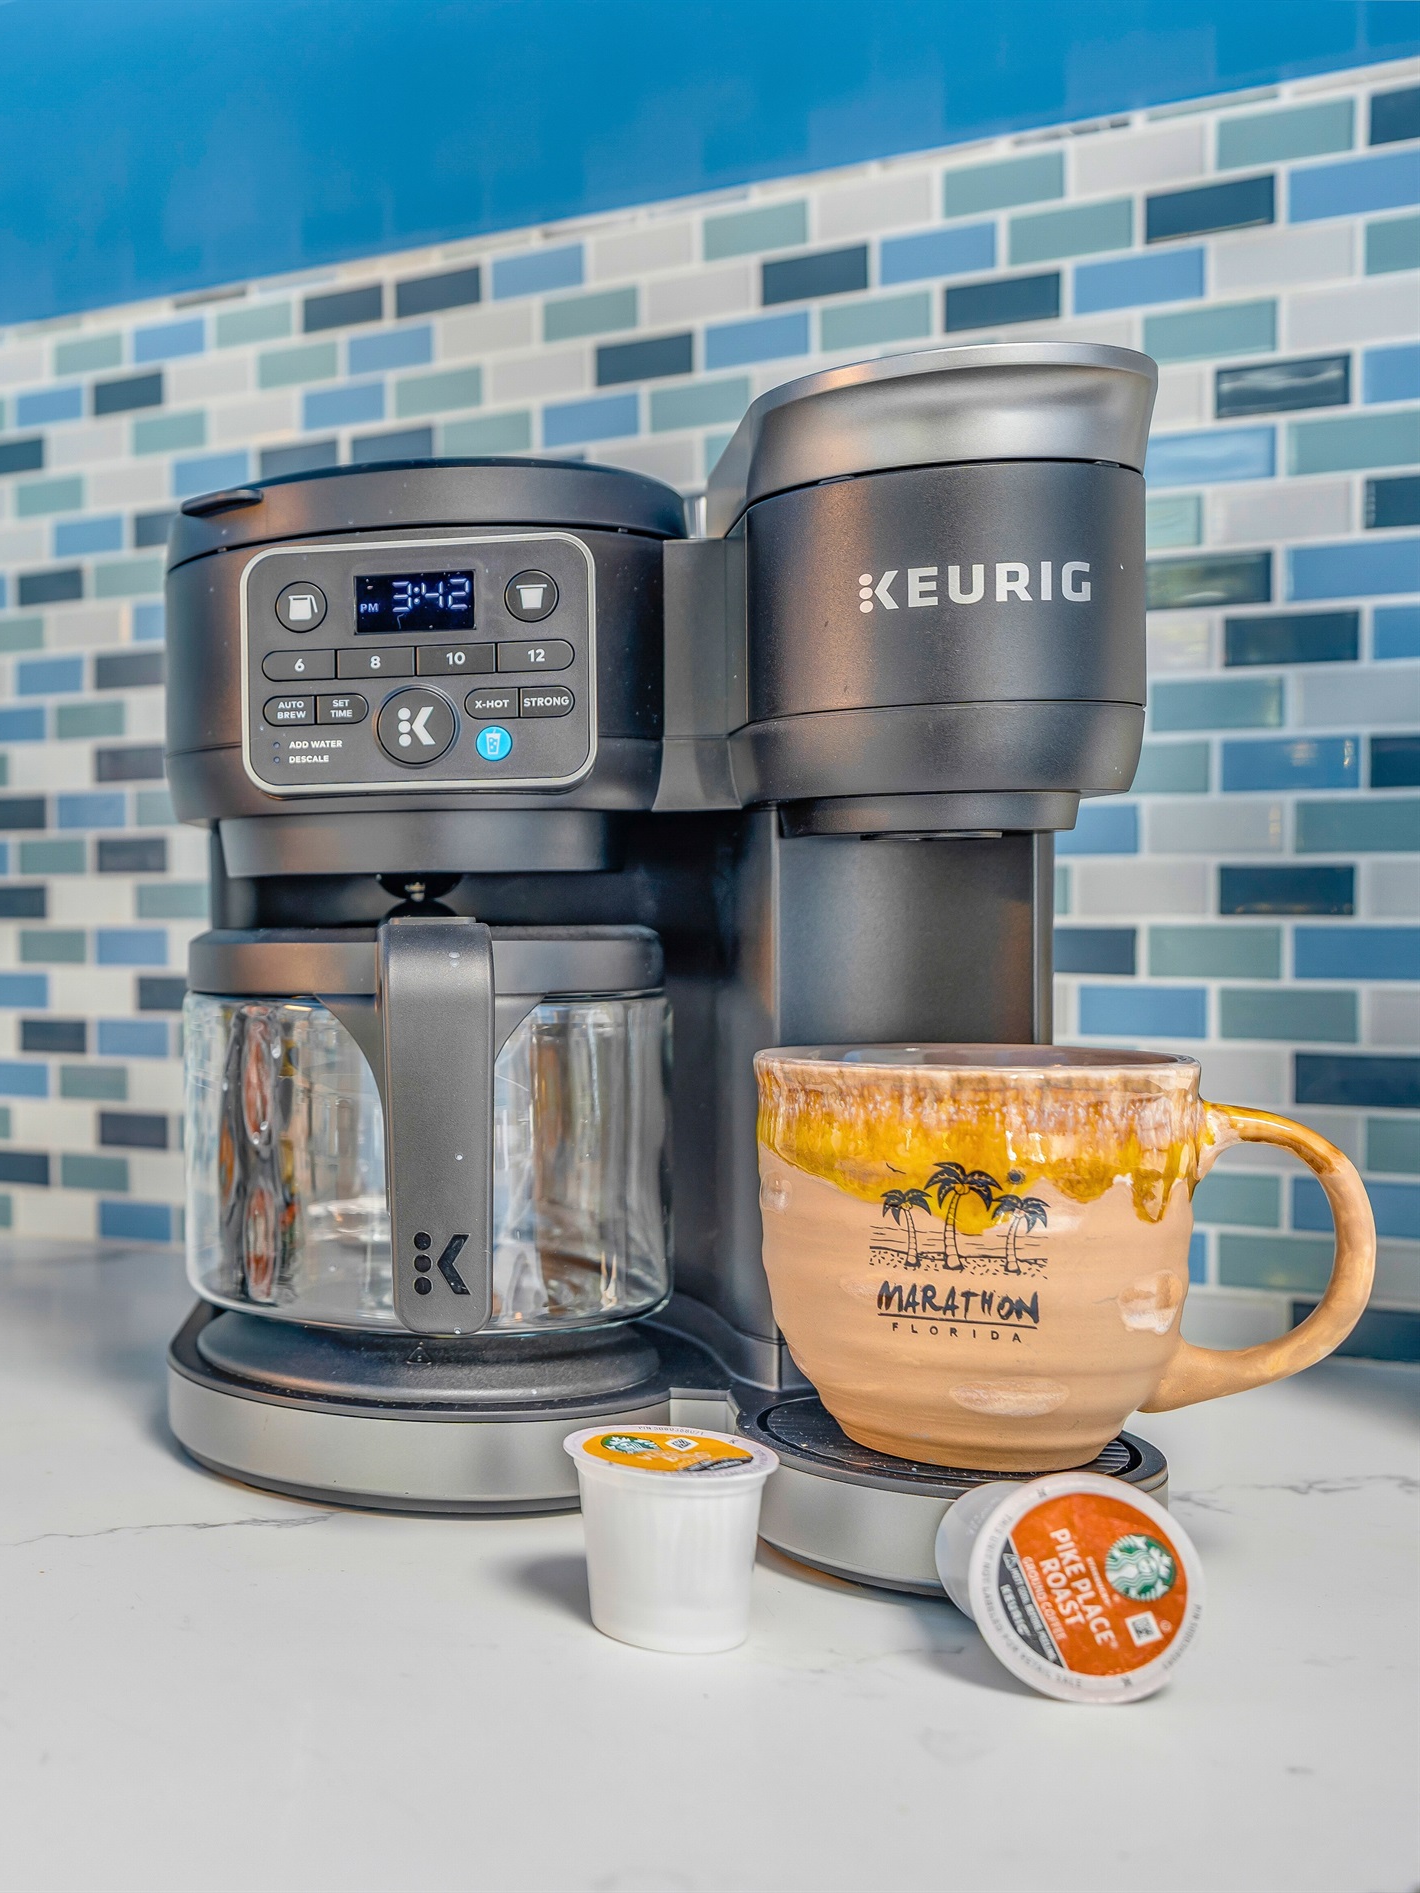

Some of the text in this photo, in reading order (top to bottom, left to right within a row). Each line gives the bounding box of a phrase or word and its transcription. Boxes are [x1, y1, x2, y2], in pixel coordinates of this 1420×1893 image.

[858, 560, 1091, 613] KEURIG
[392, 578, 470, 613] 3:42
[360, 603, 379, 613] PM
[370, 655, 381, 670] 8
[446, 651, 466, 665] 10
[528, 649, 545, 662] 12
[294, 658, 305, 672] 6
[278, 701, 304, 709] AUTO
[332, 699, 350, 707] SET
[475, 700, 509, 709] X-HOT
[524, 696, 569, 707] STRONG
[277, 711, 306, 719] BREW
[330, 709, 352, 717] TIME
[289, 740, 343, 749] ADD WATER
[289, 755, 329, 764] DESCALE
[877, 1280, 1040, 1324] MARATHON
[892, 1322, 1022, 1343] FLORIDA
[1038, 1557, 1085, 1626] ROAST
[1049, 1527, 1115, 1646] PIKE PLACE
[1021, 1556, 1048, 1604] GROUND
[1042, 1601, 1068, 1641] COFFEE
[999, 1584, 1031, 1638] KEURIG
